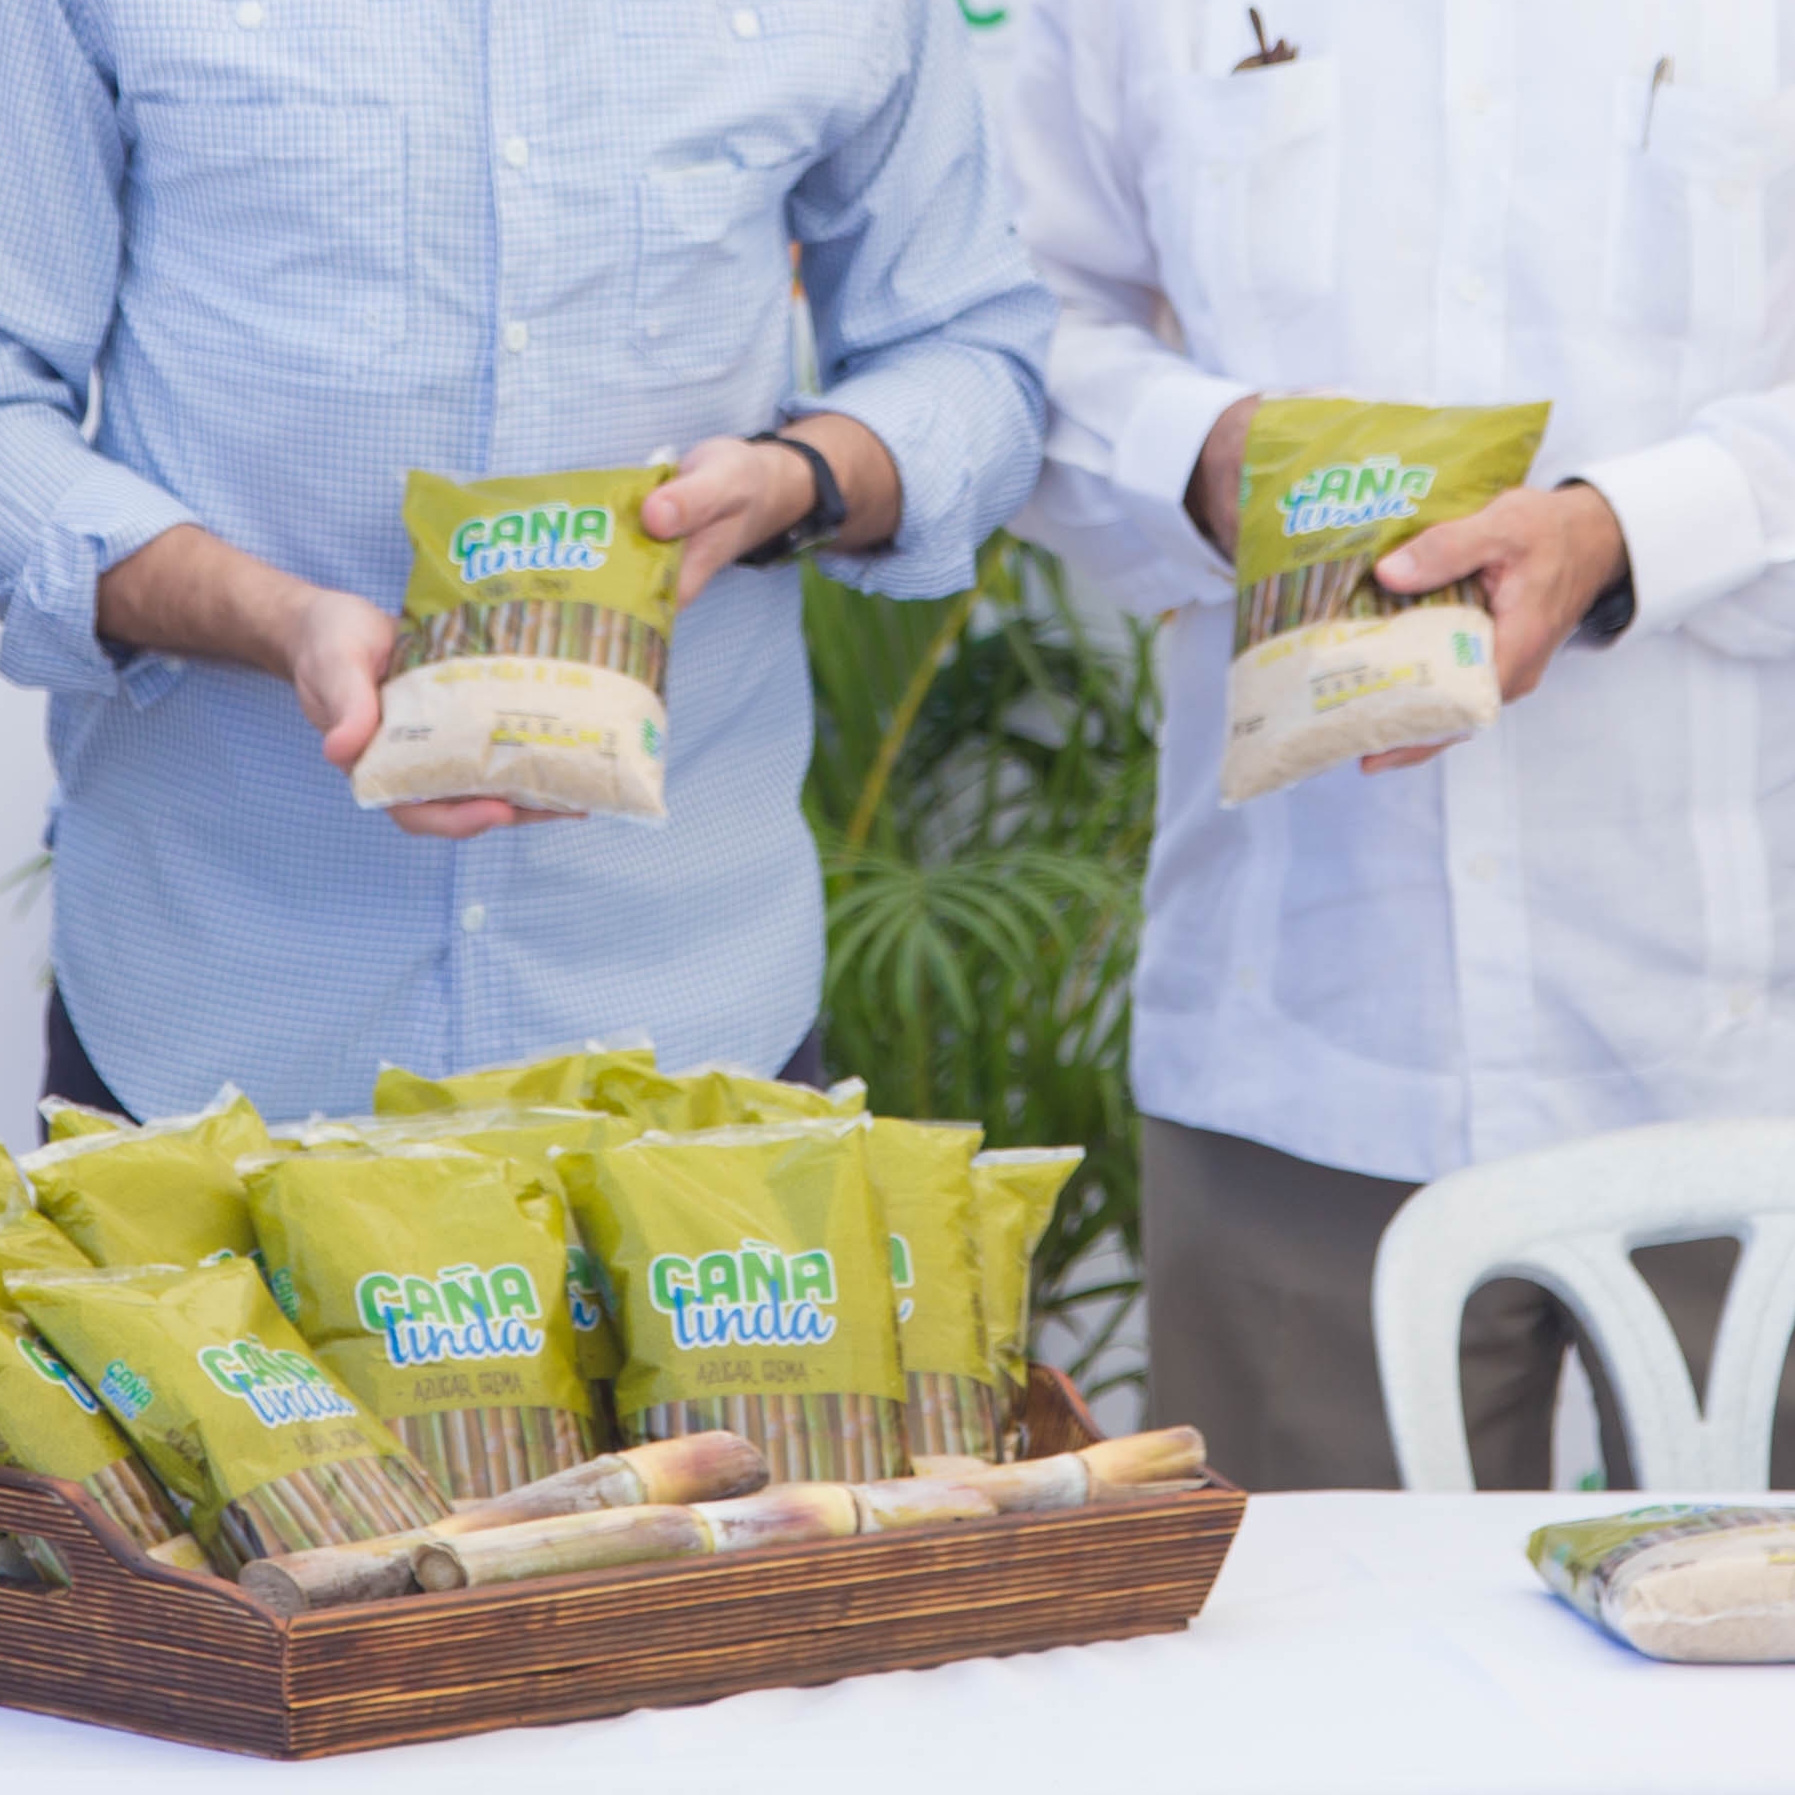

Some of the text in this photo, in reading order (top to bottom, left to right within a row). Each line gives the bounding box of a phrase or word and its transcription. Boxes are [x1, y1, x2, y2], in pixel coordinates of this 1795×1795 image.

[454, 503, 609, 559] CAÑA
[464, 529, 602, 581] linda
[359, 1265, 539, 1331] CAÑA
[653, 1239, 833, 1310] CAÑA
[383, 1301, 541, 1364] linda
[673, 1279, 834, 1345] linda
